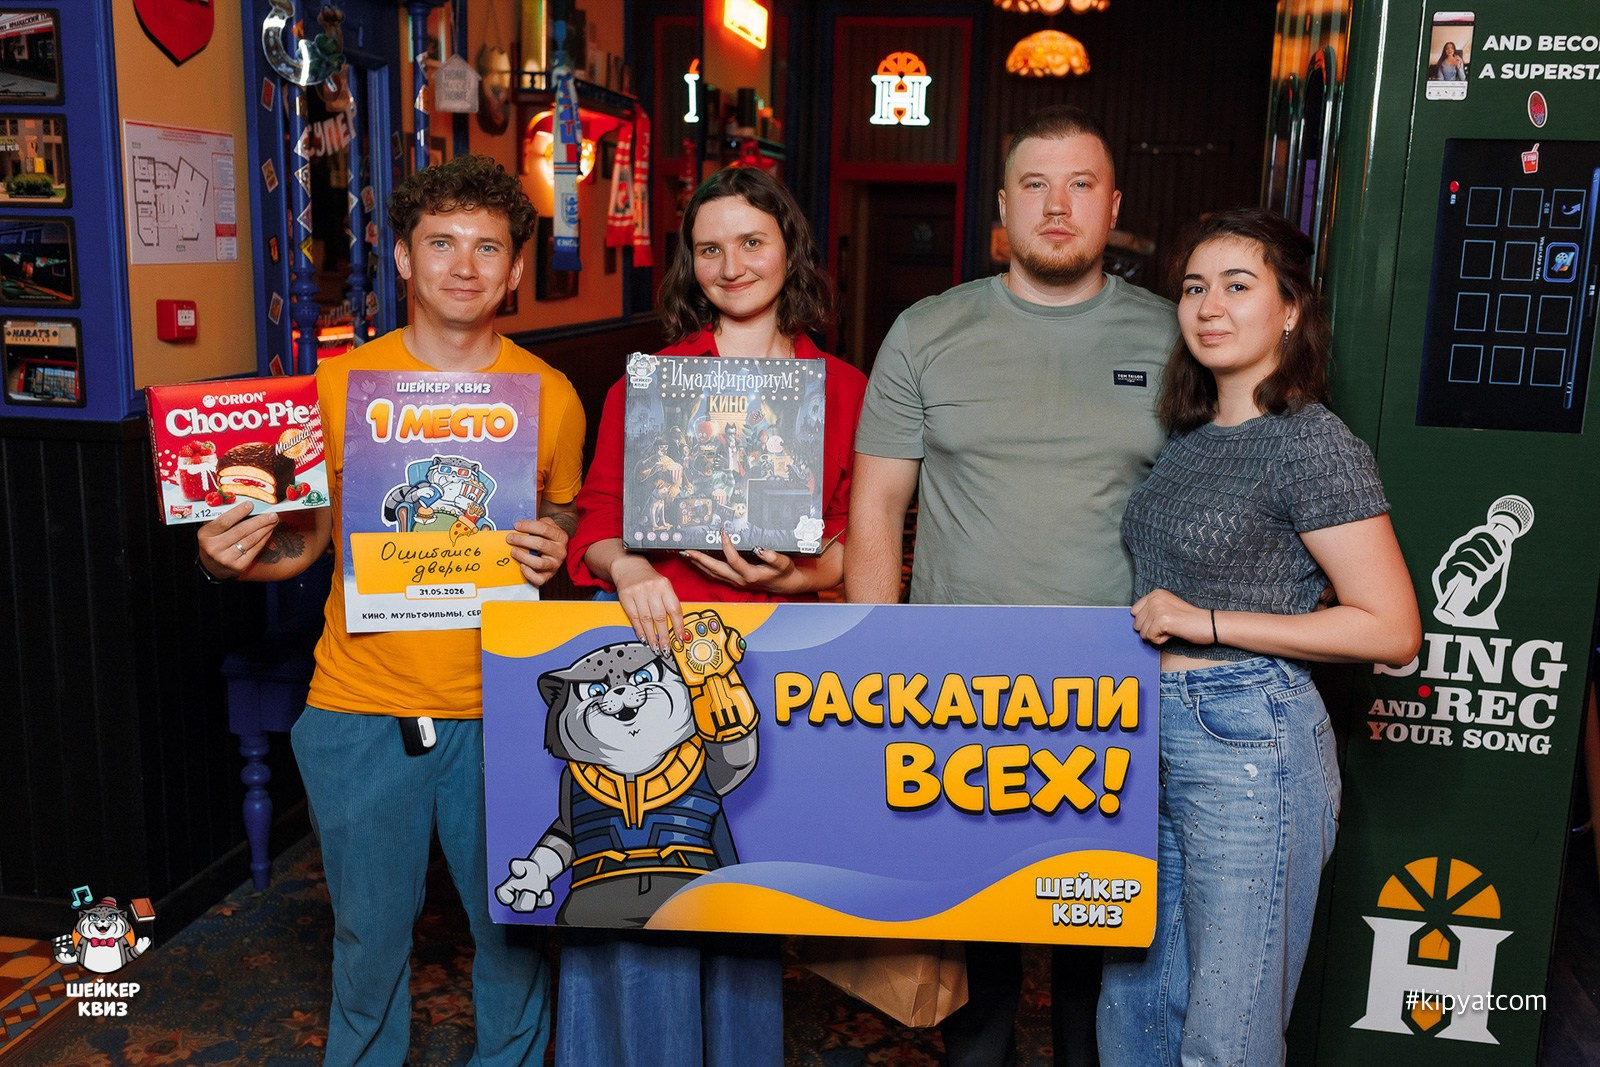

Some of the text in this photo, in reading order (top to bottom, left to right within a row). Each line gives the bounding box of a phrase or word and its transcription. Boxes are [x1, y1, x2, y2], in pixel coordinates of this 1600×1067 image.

[1482, 35, 1600, 52] AND BECO
[1478, 63, 1495, 79] A
[396, 380, 491, 394] ШЕЙКЕР КВИЗ
[668, 360, 793, 394] Имаджинариум
[218, 392, 263, 406] ORION
[709, 395, 748, 413] КИНО
[368, 401, 516, 441] 1 МЕСТО
[411, 561, 481, 583] дверью
[419, 588, 465, 596] 31.05.2026
[391, 610, 465, 620] МУЛЬТФИЛЬМЫ,
[774, 671, 1140, 732] РАСКАТАЛИ
[1368, 686, 1558, 729] AND REC
[1367, 721, 1552, 755] YOUR SONG
[885, 742, 1131, 817] ВСЕХ!
[1035, 873, 1142, 902] ШЕЙКЕР
[1051, 903, 1123, 928] КВИЗ
